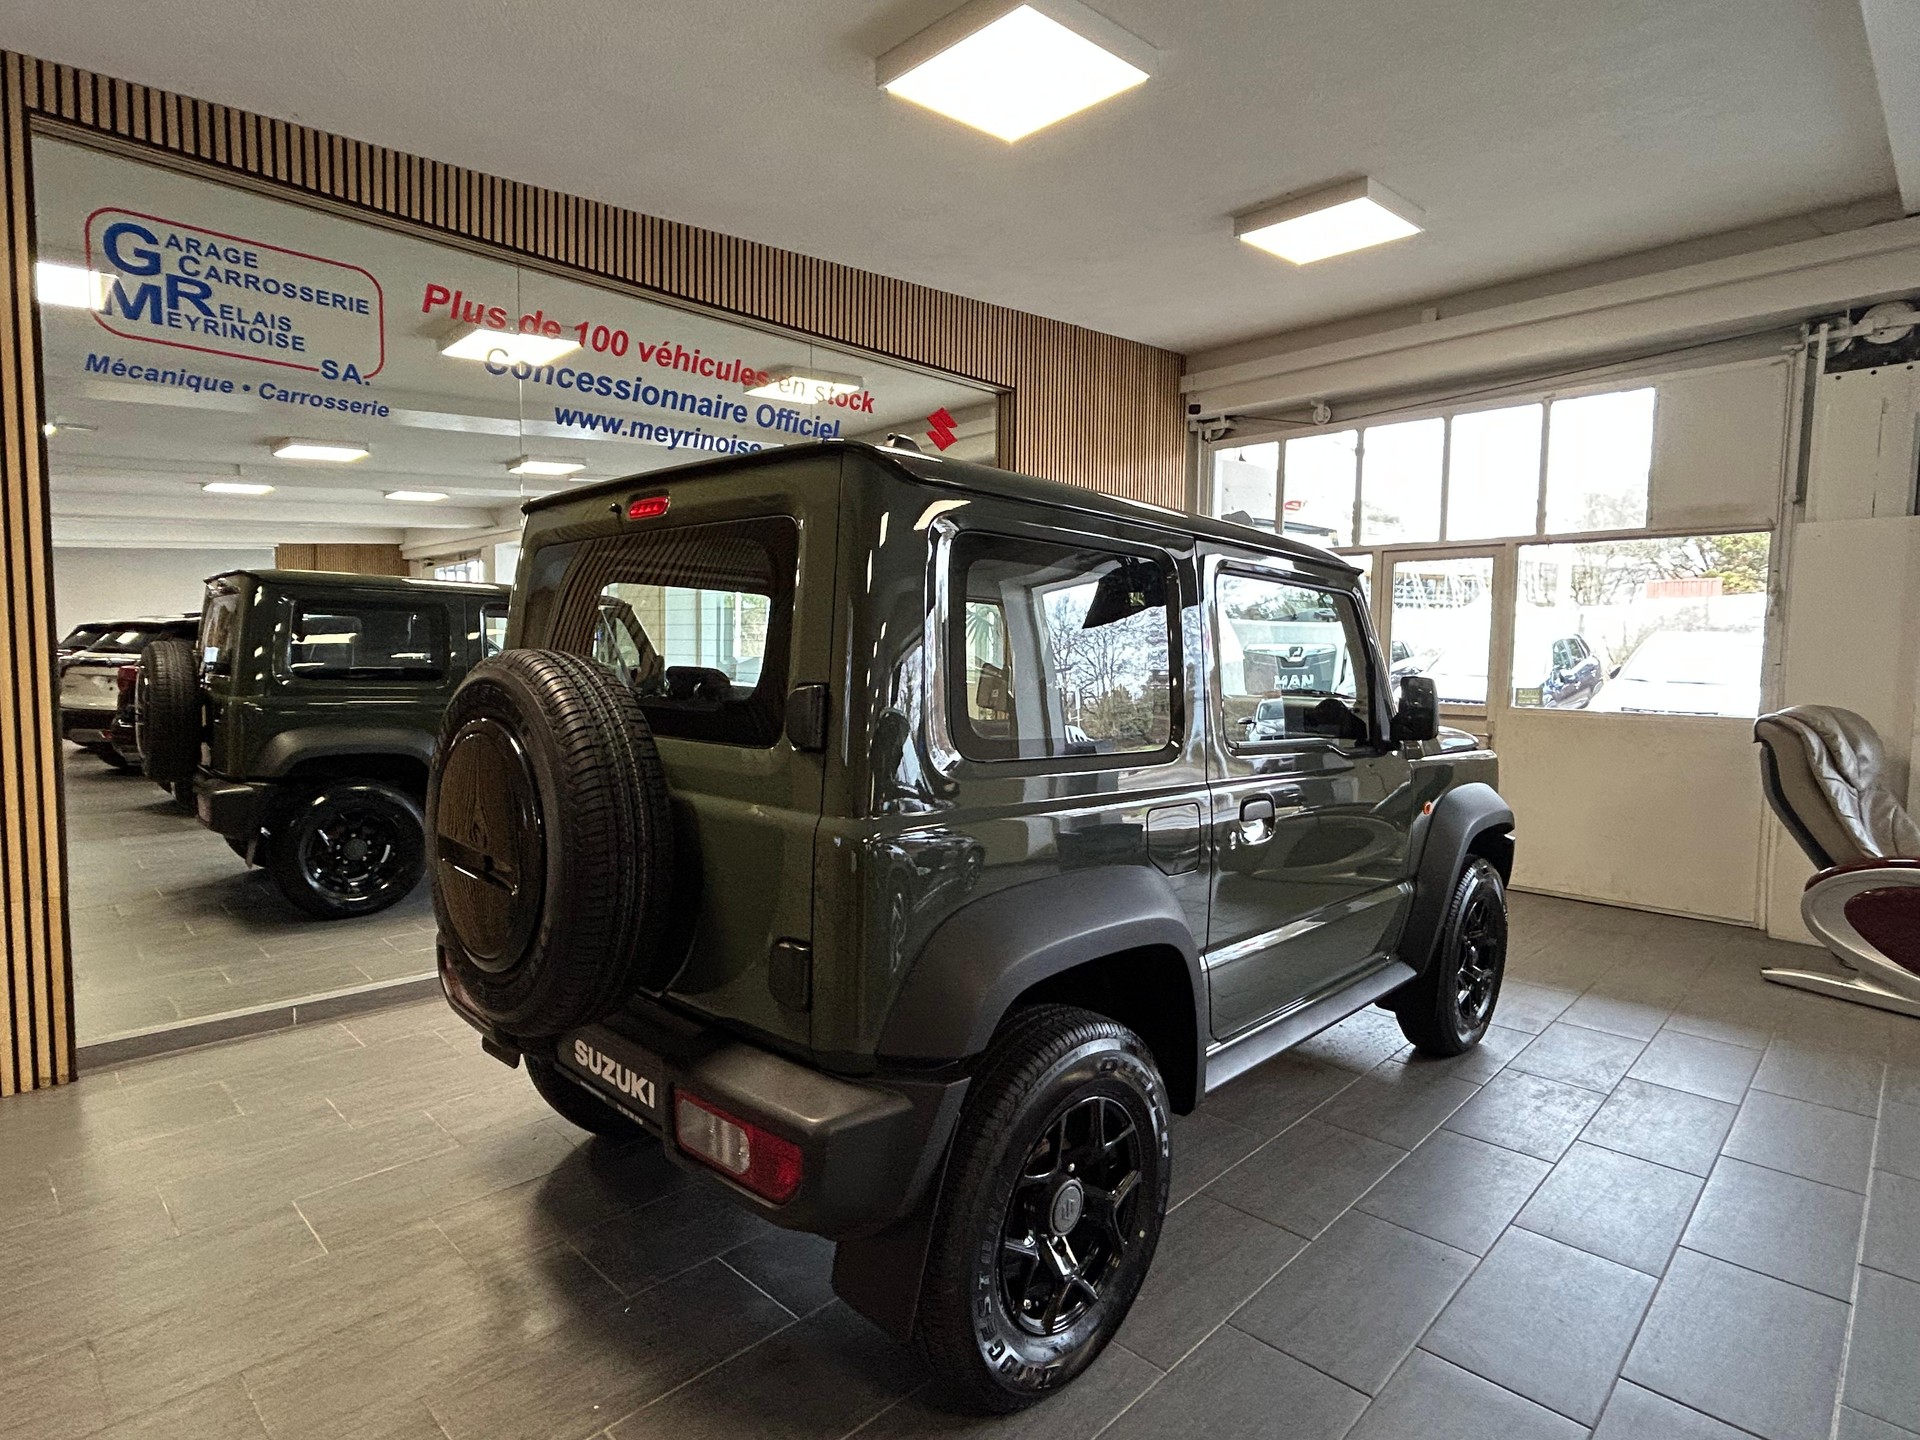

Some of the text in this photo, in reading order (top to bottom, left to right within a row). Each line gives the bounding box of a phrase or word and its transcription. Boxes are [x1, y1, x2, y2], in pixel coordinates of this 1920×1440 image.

[103, 222, 258, 276] GARAGE
[102, 278, 306, 351] MEYRINOISE
[166, 273, 294, 332] RELAIS
[178, 255, 370, 315] CARROSSERIE
[421, 283, 875, 414] Plus de 100 véhicules en stock
[85, 353, 390, 417] Mécanique Carrosserie
[484, 348, 841, 439] Concessionnaire Officiel
[574, 1039, 655, 1109] SUZUKI
